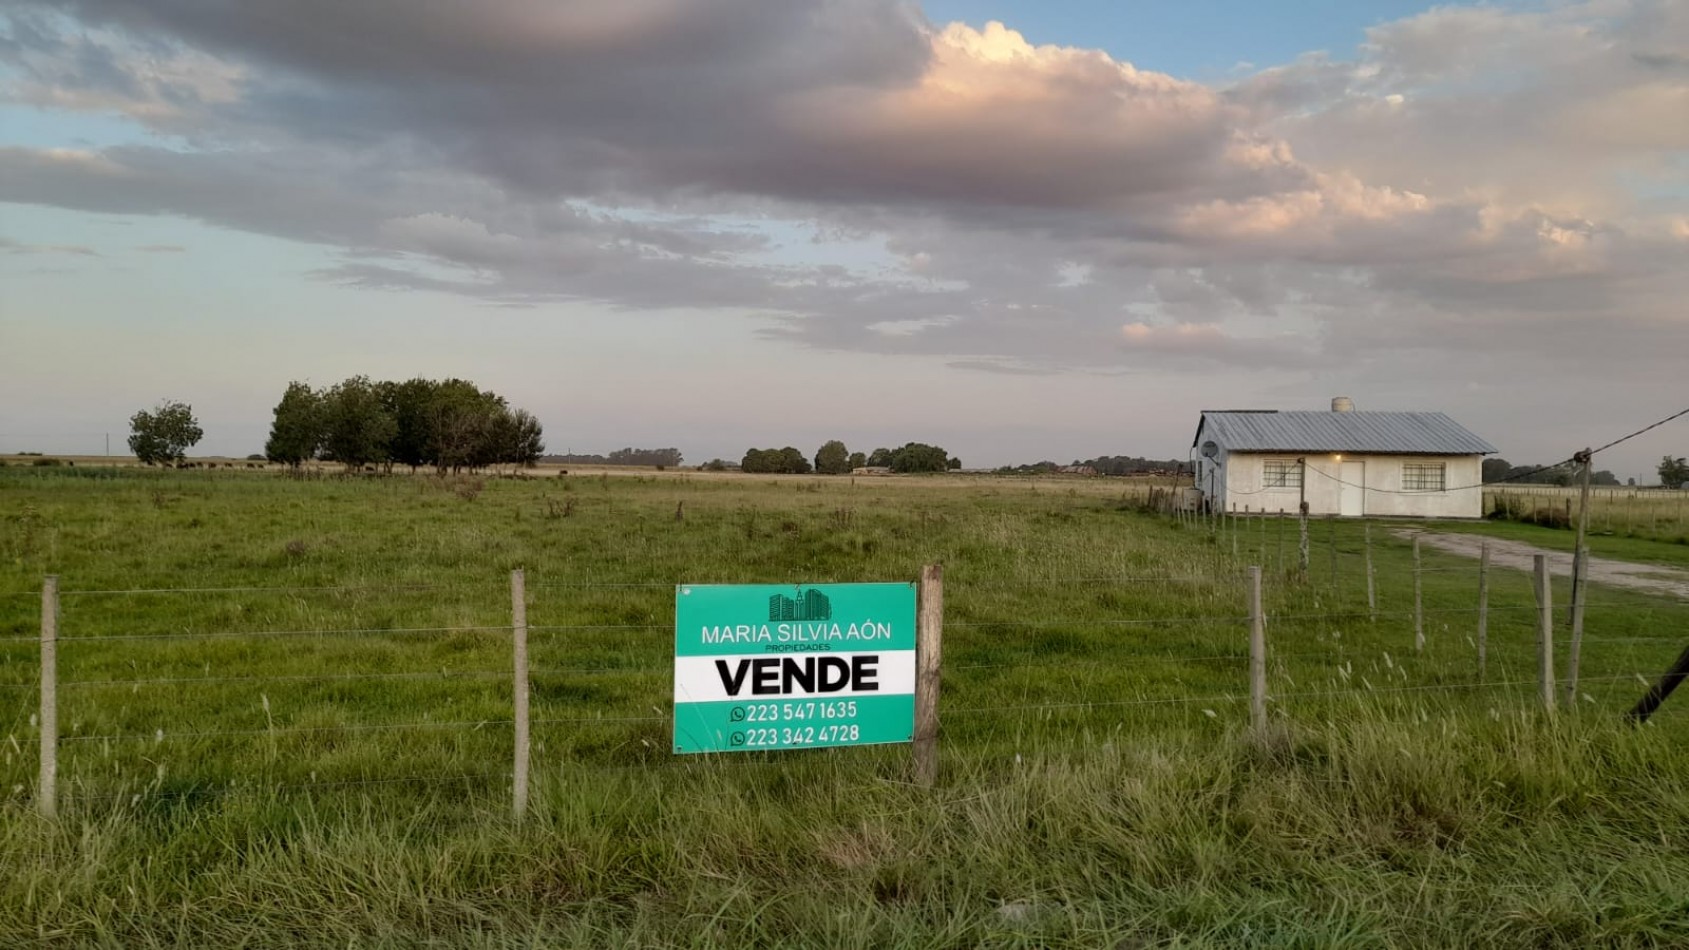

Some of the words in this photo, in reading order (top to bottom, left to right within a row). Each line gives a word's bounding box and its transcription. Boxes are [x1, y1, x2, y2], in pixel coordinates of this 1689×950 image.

[701, 625, 772, 644] MARIA
[777, 621, 843, 642] SILVIA
[846, 618, 891, 640] AÓN
[765, 643, 831, 653] PROPIEDADES
[715, 655, 879, 696] VENDE
[746, 704, 778, 721] 223
[783, 702, 815, 720] 547
[819, 701, 857, 719] 1635
[746, 729, 778, 746] 223
[782, 727, 814, 744] 342
[818, 724, 860, 742] 4728
